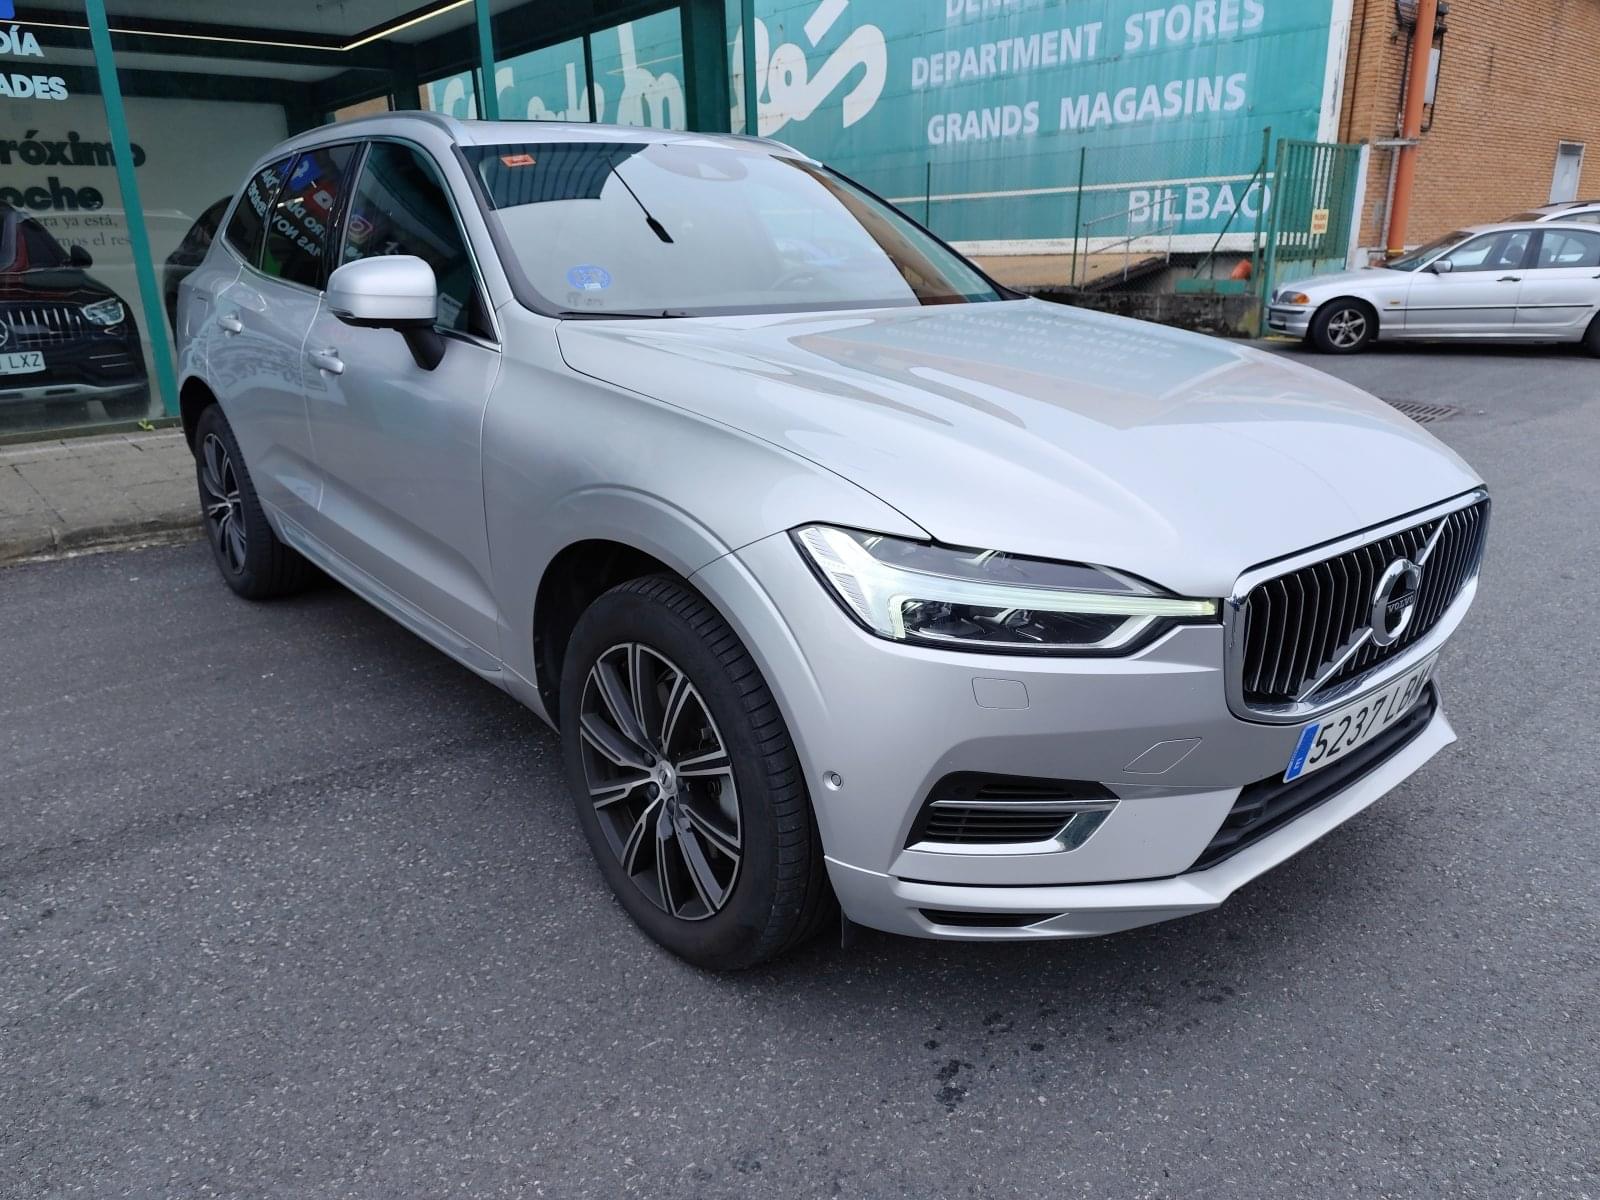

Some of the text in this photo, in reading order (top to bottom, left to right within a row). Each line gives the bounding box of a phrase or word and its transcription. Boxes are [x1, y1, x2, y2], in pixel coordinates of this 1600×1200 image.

[911, 0, 1265, 89] DEPARTMENT STORES
[927, 73, 1247, 145] GRANDS MAGASINS
[1128, 182, 1271, 222] BILBAO
[62, 217, 79, 229] ya
[93, 231, 105, 246] el
[8, 353, 41, 369] LXZ
[1309, 695, 1388, 764] 5237
